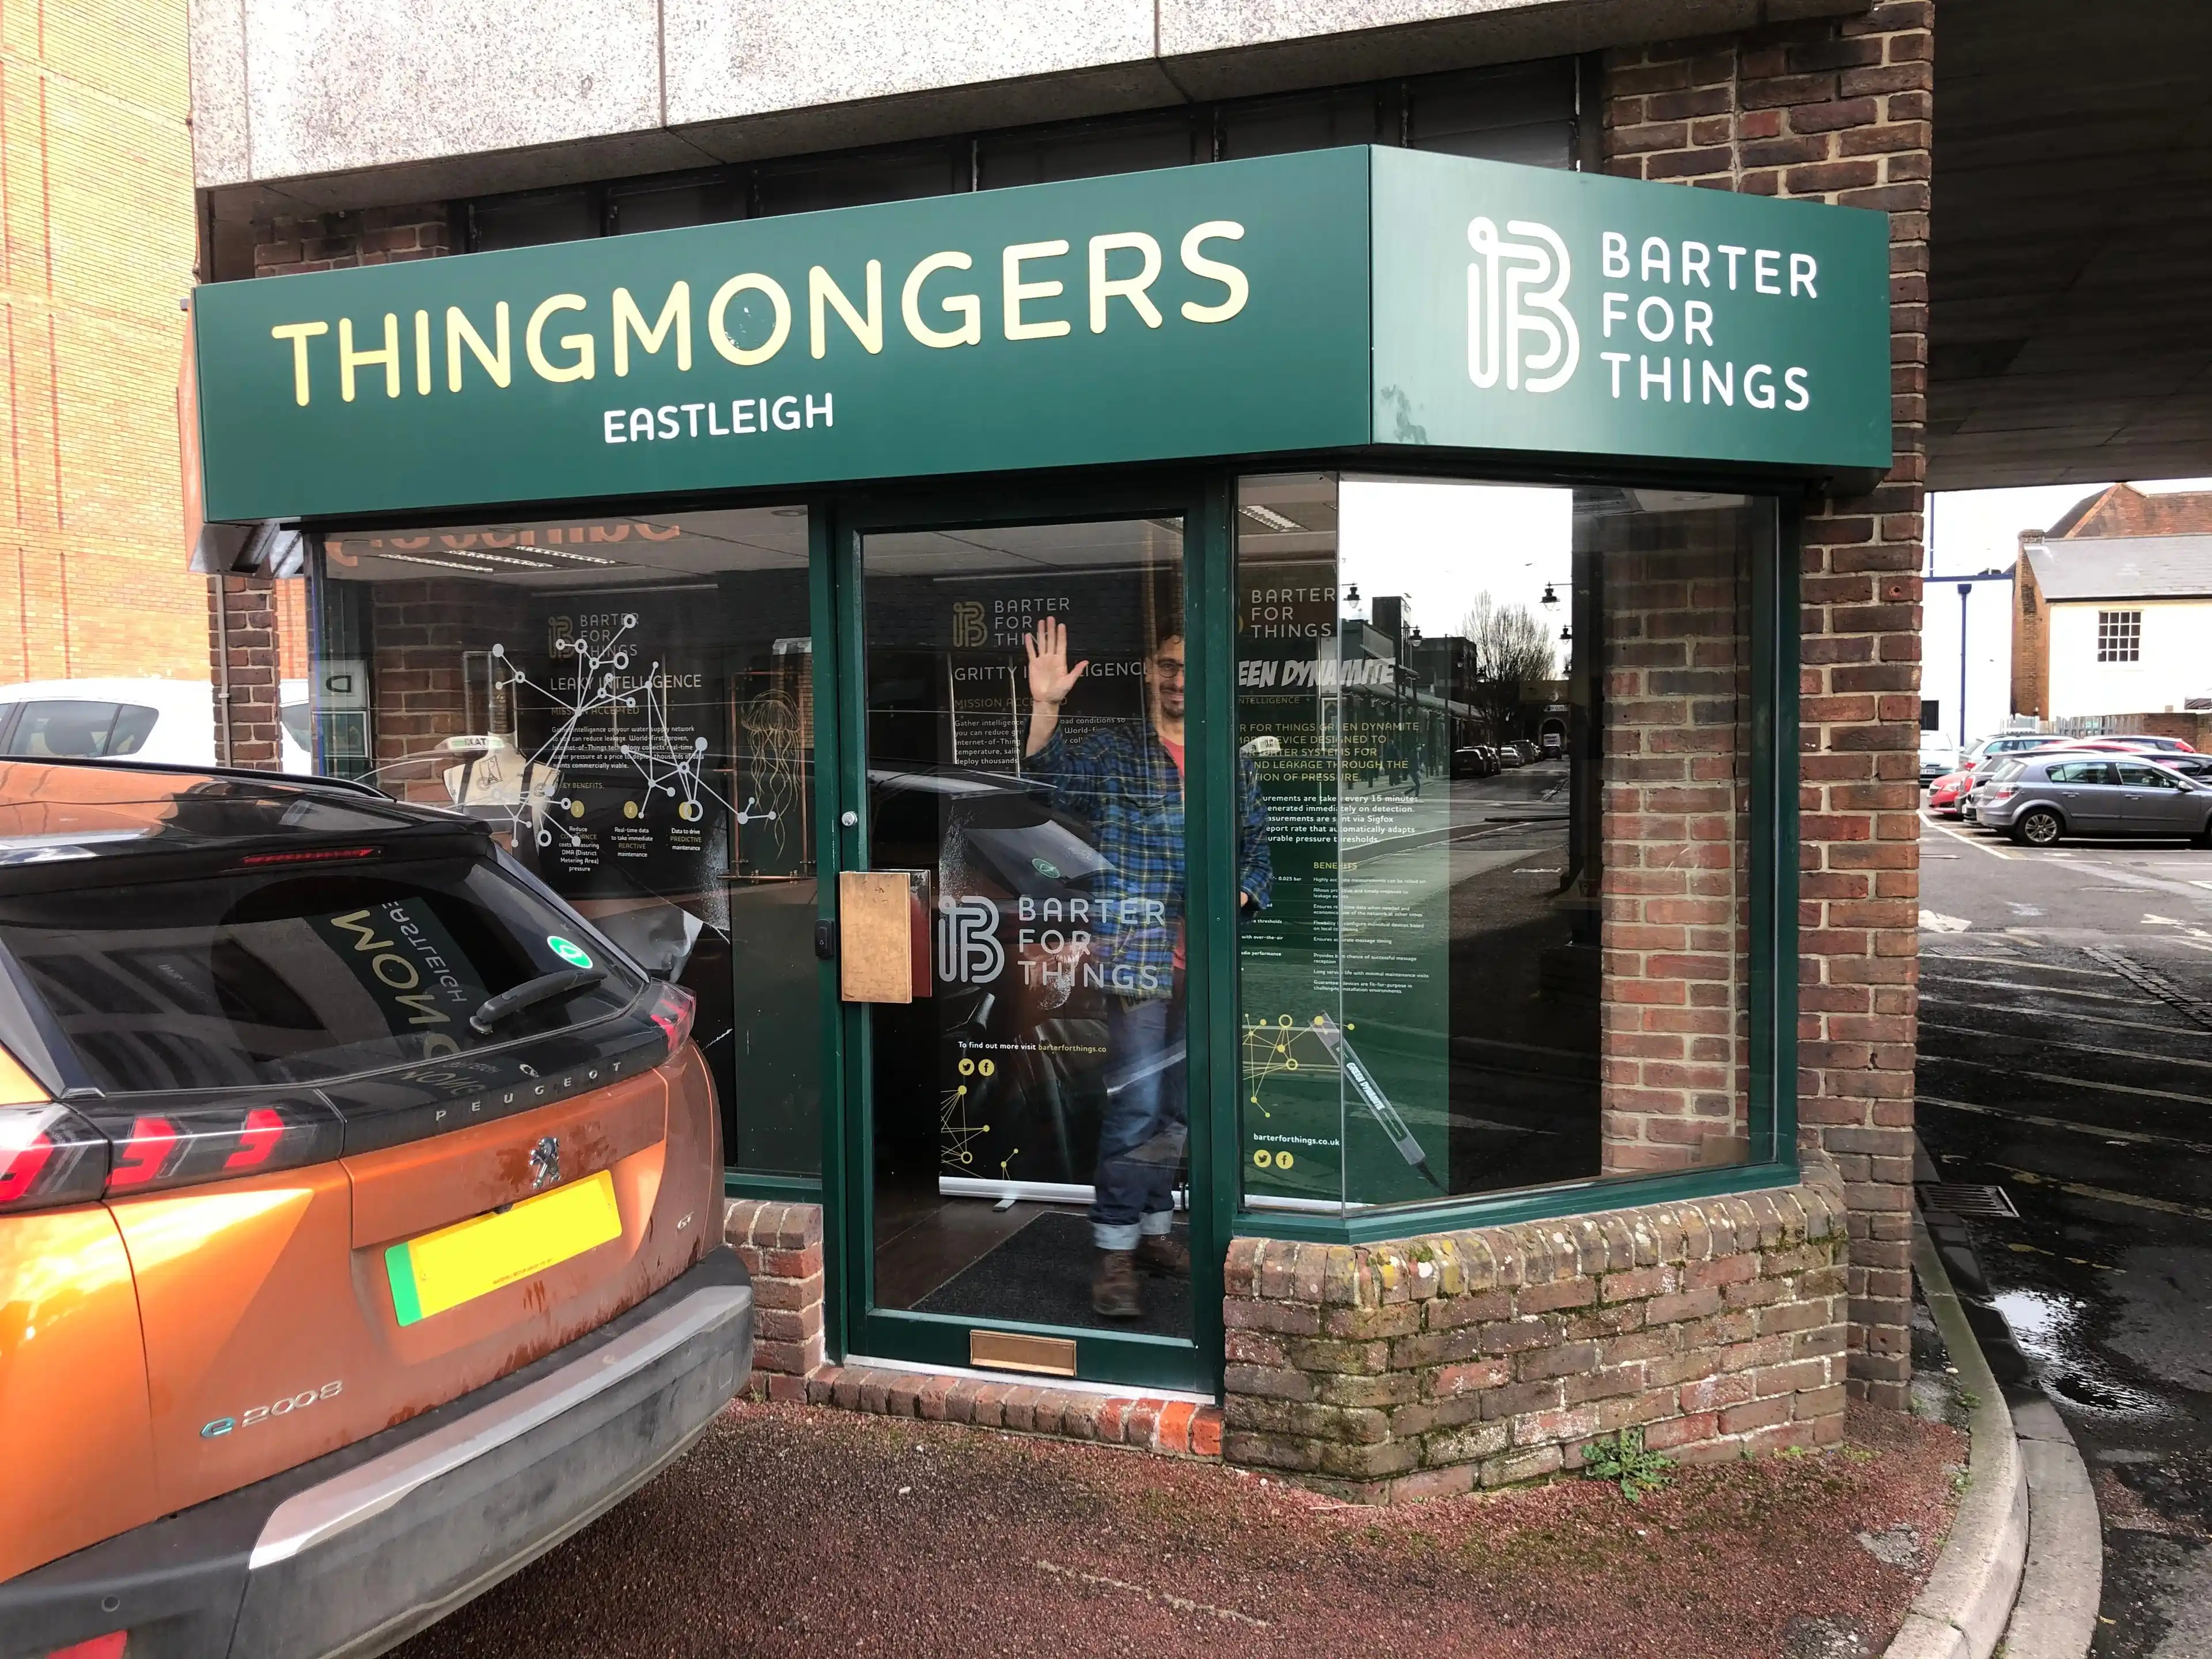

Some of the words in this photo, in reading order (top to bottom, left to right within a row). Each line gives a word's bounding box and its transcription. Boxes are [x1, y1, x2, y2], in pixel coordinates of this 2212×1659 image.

[1602, 232, 1817, 298] BARTER
[271, 221, 1249, 406] THINGMONGERS
[1603, 292, 1714, 346] FOR
[1600, 352, 1810, 411] THINGS
[604, 393, 833, 442] EASTLEIGH
[1251, 588, 1335, 604] BARTER
[994, 597, 1070, 613] BARTER
[579, 613, 639, 627] BARTER
[1251, 606, 1294, 622] FOR
[994, 615, 1033, 629] FOR
[580, 630, 611, 642] FOR
[1251, 623, 1332, 639] THINGS
[955, 665, 1017, 680] GRITTY
[1281, 657, 1396, 688] DYNAMITE
[550, 677, 594, 691] LEAKY
[955, 698, 1002, 709] MISSION
[1238, 696, 1300, 704] NTELLIGENCE
[551, 707, 589, 716] MISSN
[591, 706, 639, 715] ACCEPTED
[982, 718, 1024, 728] intelligence
[1075, 717, 1115, 725] conditions
[1250, 724, 1272, 732] FOR
[1275, 724, 1316, 732] THINGS
[1361, 722, 1419, 731] DYNAMITE
[573, 726, 606, 734] intelligence
[605, 735, 627, 743] leakage.
[1279, 736, 1306, 744] EVICE
[1370, 735, 1387, 743] TO
[955, 748, 1002, 756] temperature,
[572, 762, 609, 770] commercially
[955, 757, 979, 766] deploy
[980, 757, 1018, 765] thousands
[1253, 760, 1270, 768] ND
[1326, 760, 1383, 768] THROUGH
[1386, 760, 1408, 768] THE
[1283, 773, 1298, 781] OF
[1367, 815, 1393, 824] Sigfox
[1018, 897, 1166, 926] BARTER
[1018, 928, 1091, 956] FOR
[1017, 960, 1158, 990] THINGS
[435, 1062, 621, 1122] PEUGEOT
[1253, 1133, 1340, 1146] barterforthings.co.uk
[241, 1380, 343, 1428] 2008
